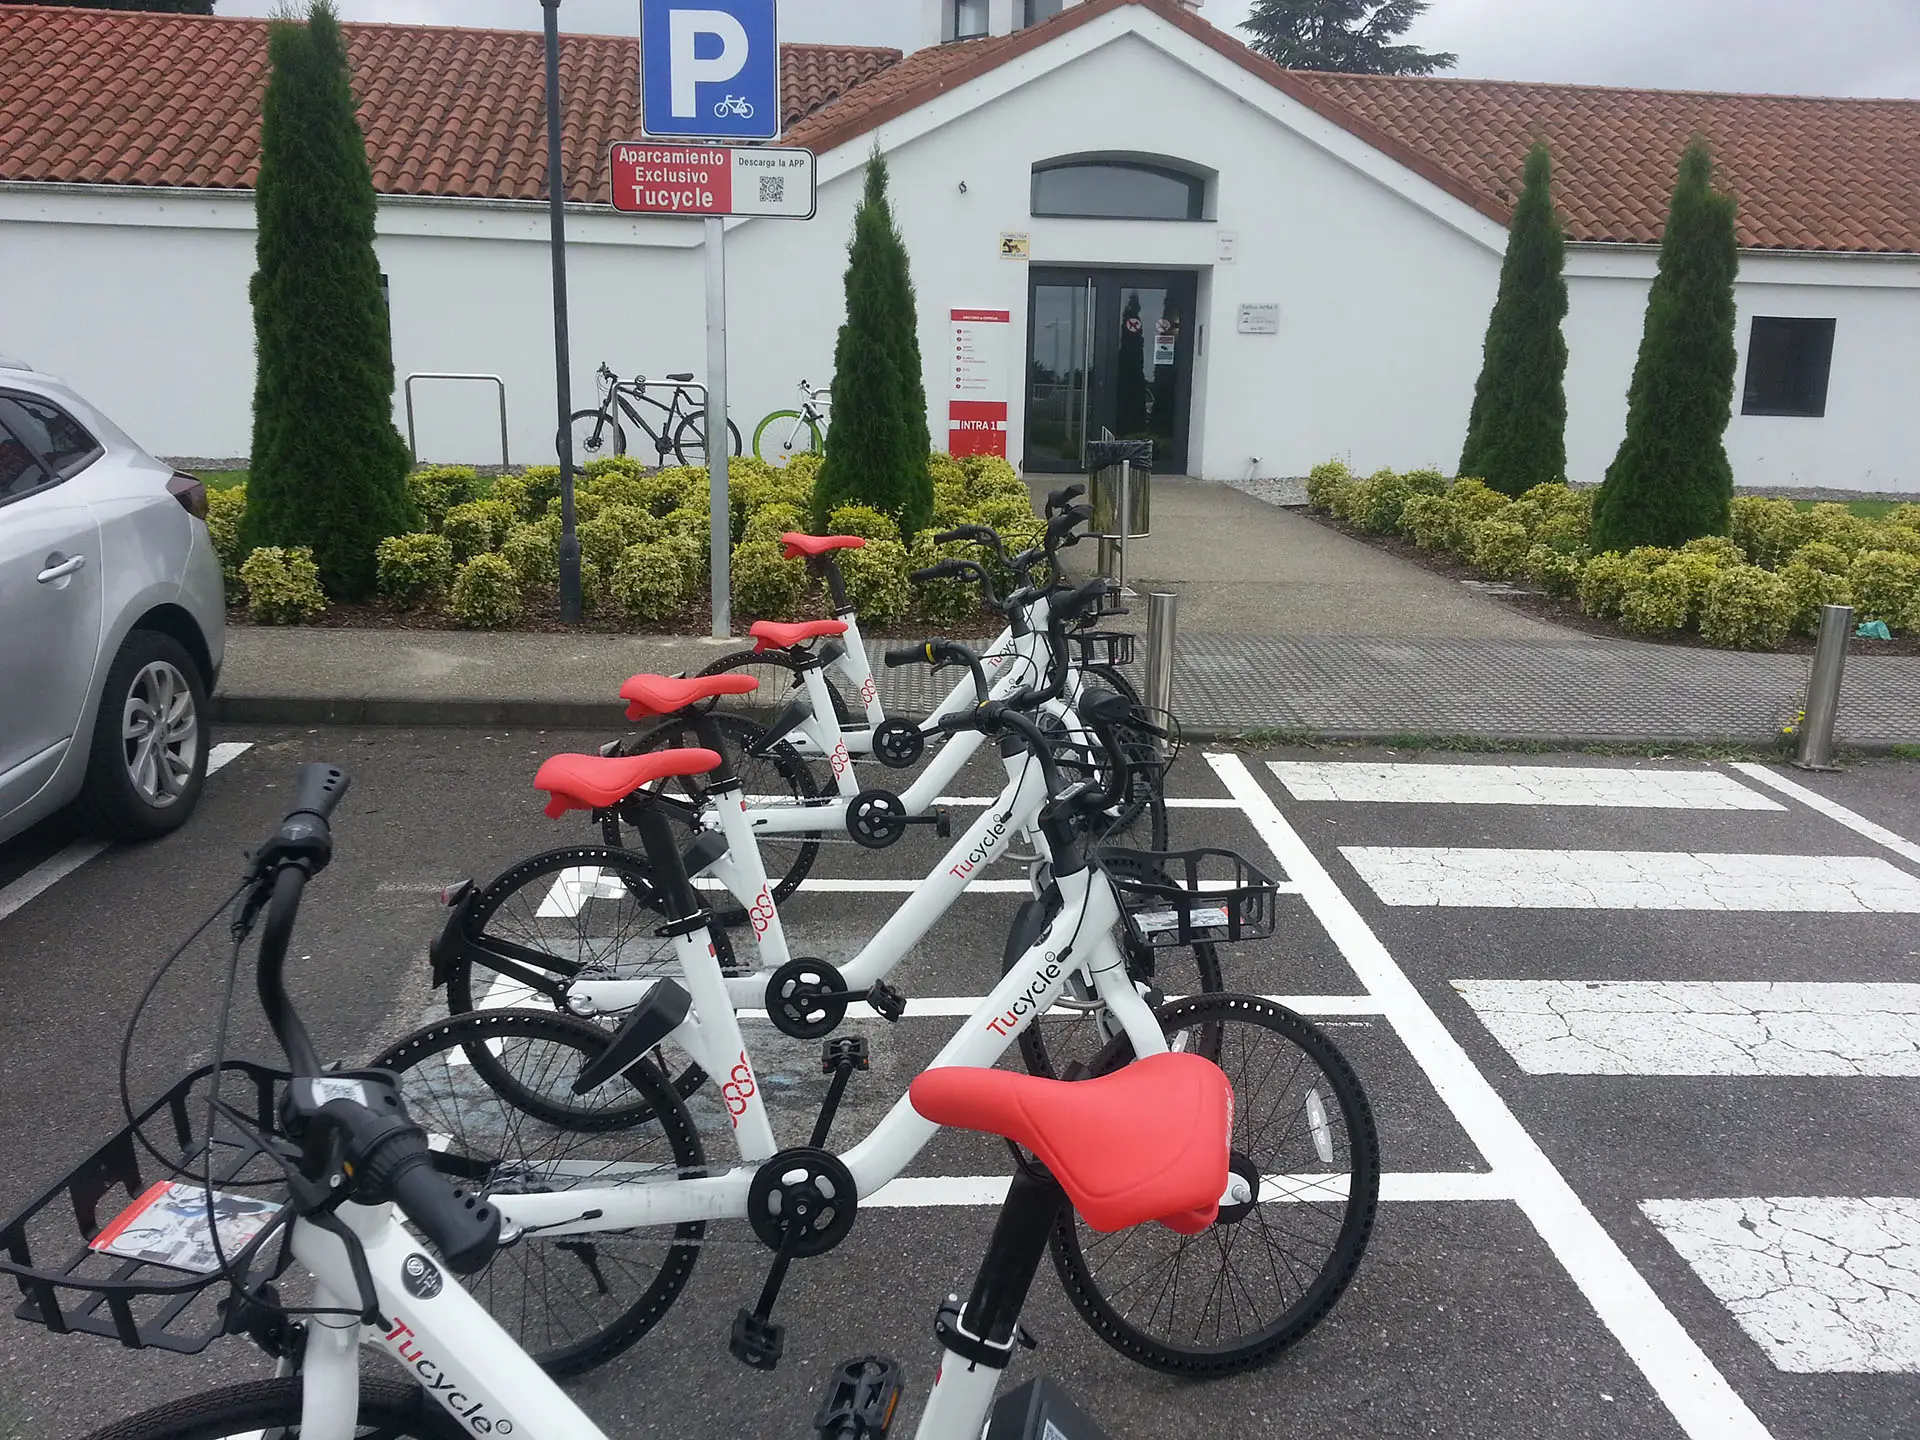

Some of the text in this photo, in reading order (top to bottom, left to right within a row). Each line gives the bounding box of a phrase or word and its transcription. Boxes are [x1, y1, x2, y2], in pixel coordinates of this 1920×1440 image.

[669, 9, 749, 118] P
[619, 147, 724, 165] Aparcamiento
[738, 157, 805, 168] Descarga la APP
[635, 166, 709, 184] Exclusivo
[631, 185, 713, 210] Tucycle
[961, 420, 996, 431] INTRA 1
[949, 824, 1006, 879] Tucycle
[986, 964, 1061, 1036] Tucycle
[385, 1317, 492, 1434] Tucycle
